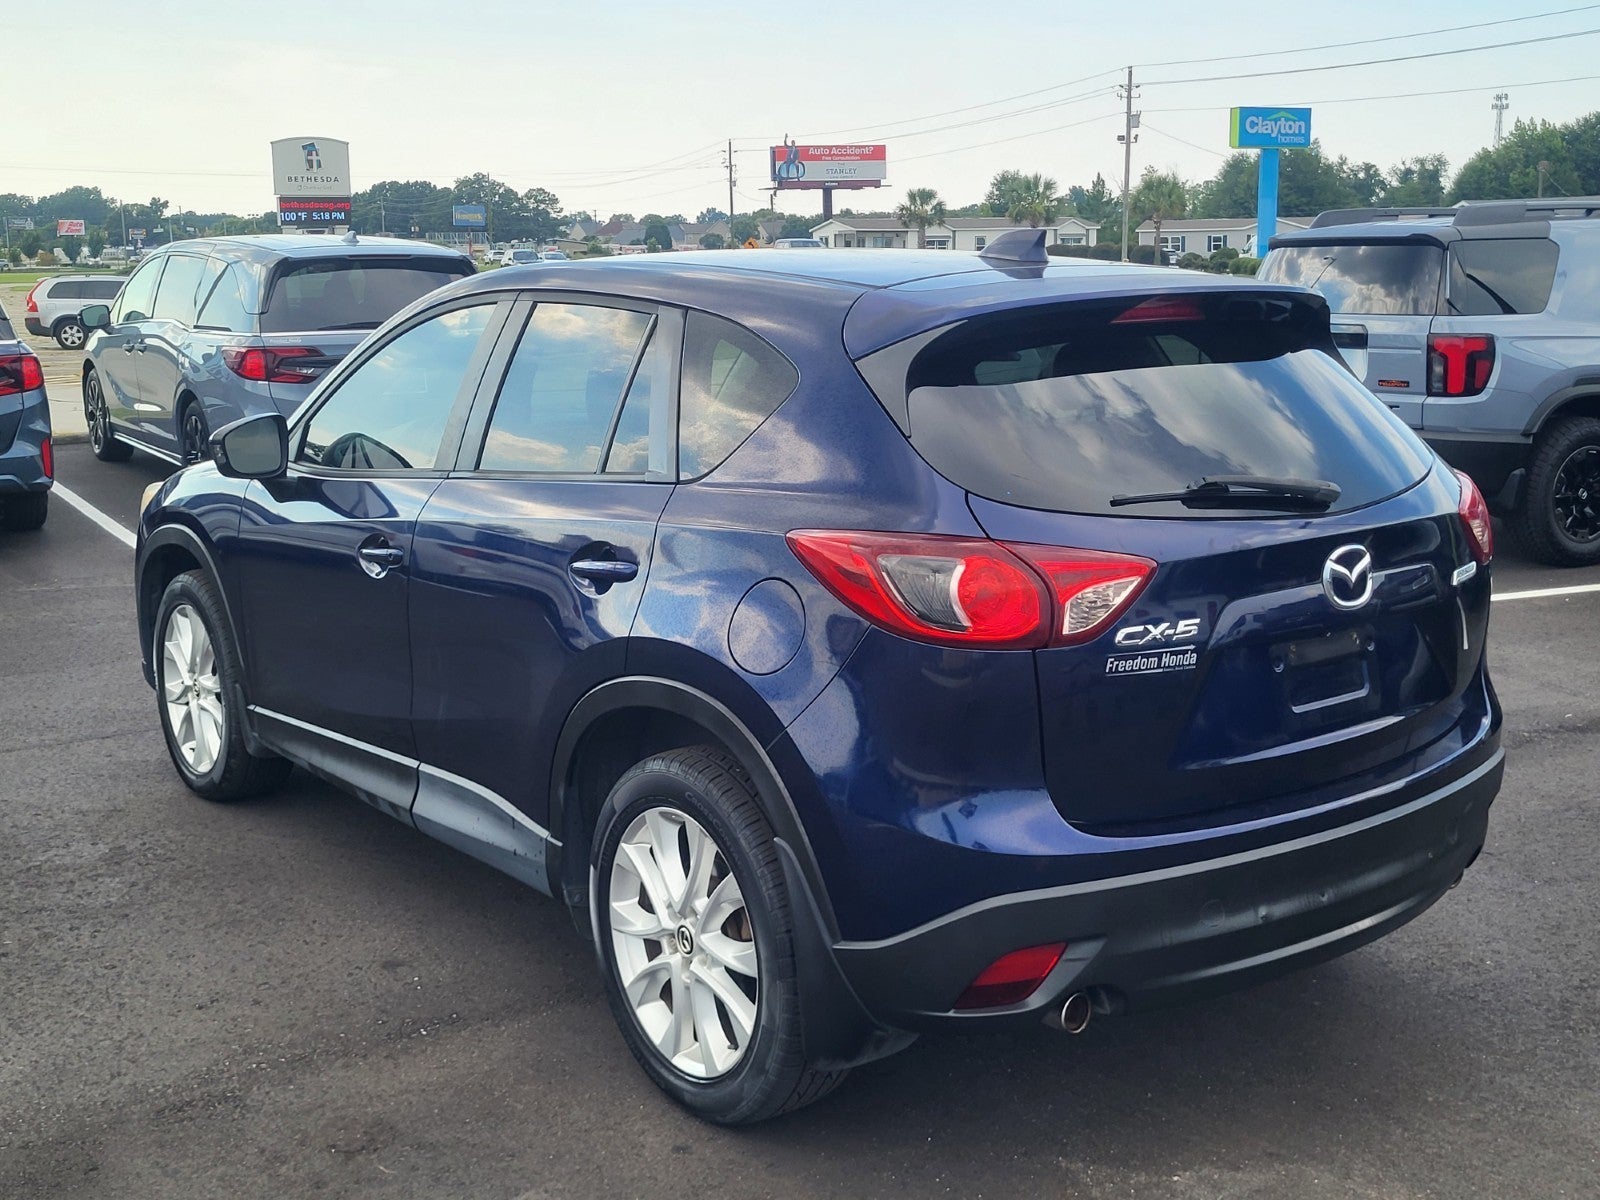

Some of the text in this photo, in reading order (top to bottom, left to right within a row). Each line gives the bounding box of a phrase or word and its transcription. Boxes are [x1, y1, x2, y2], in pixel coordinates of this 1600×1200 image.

[1245, 116, 1305, 137] Clayton
[1278, 134, 1305, 143] homes
[809, 146, 873, 155] Auto Accident?
[280, 212, 296, 221] 100
[312, 212, 330, 220] 5:18
[331, 212, 345, 220] PM
[1115, 618, 1200, 646] CX-5
[1105, 650, 1197, 673] Freedom Honda
